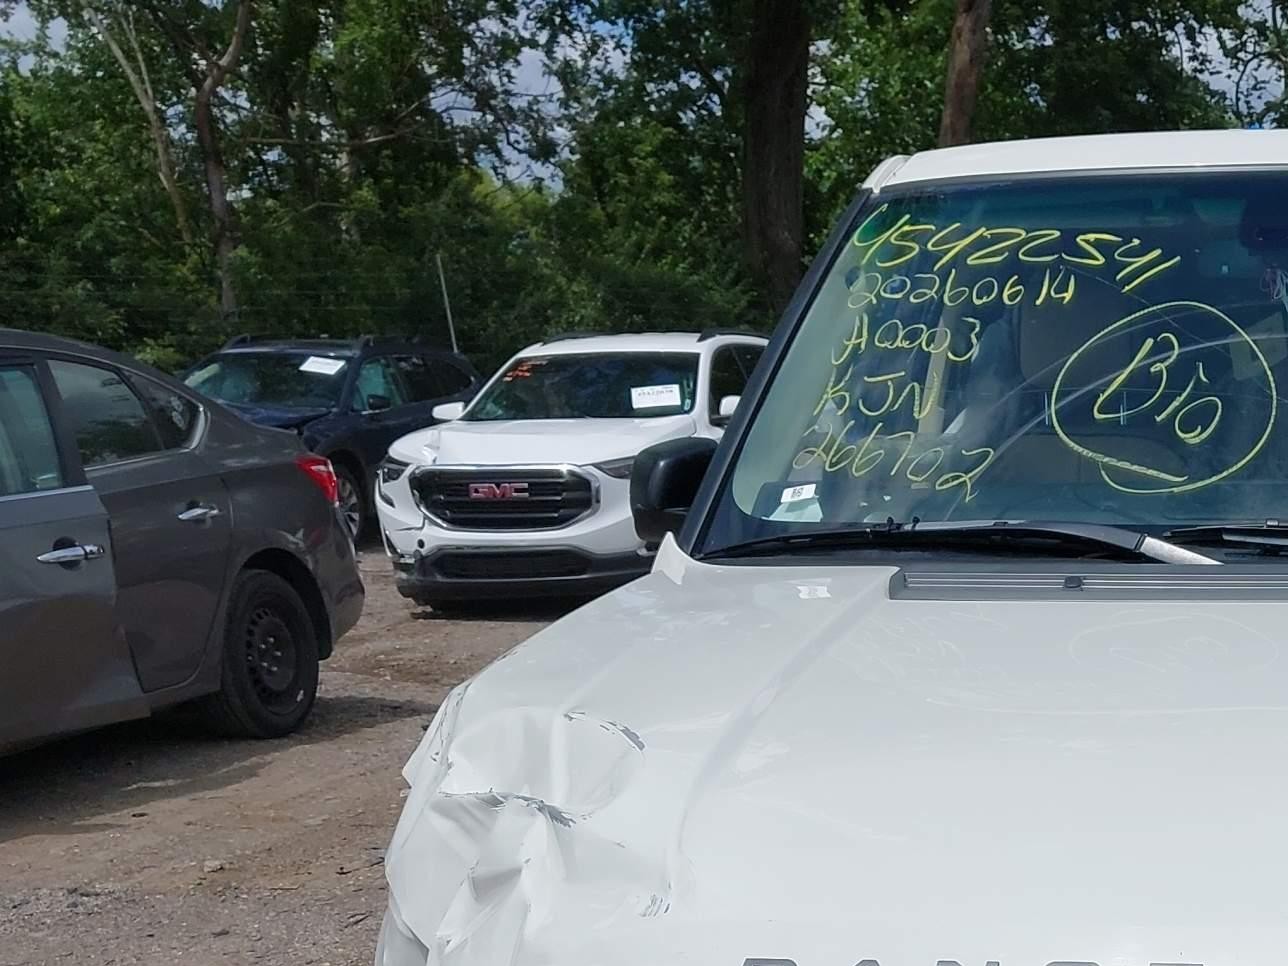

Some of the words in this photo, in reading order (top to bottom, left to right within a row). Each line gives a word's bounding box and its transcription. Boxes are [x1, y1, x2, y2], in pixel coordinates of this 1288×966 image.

[852, 204, 1181, 293] 45422541
[847, 266, 1076, 307] 20260614
[831, 312, 982, 366] A0003
[792, 420, 994, 503] 266702
[468, 483, 529, 499] GMC
